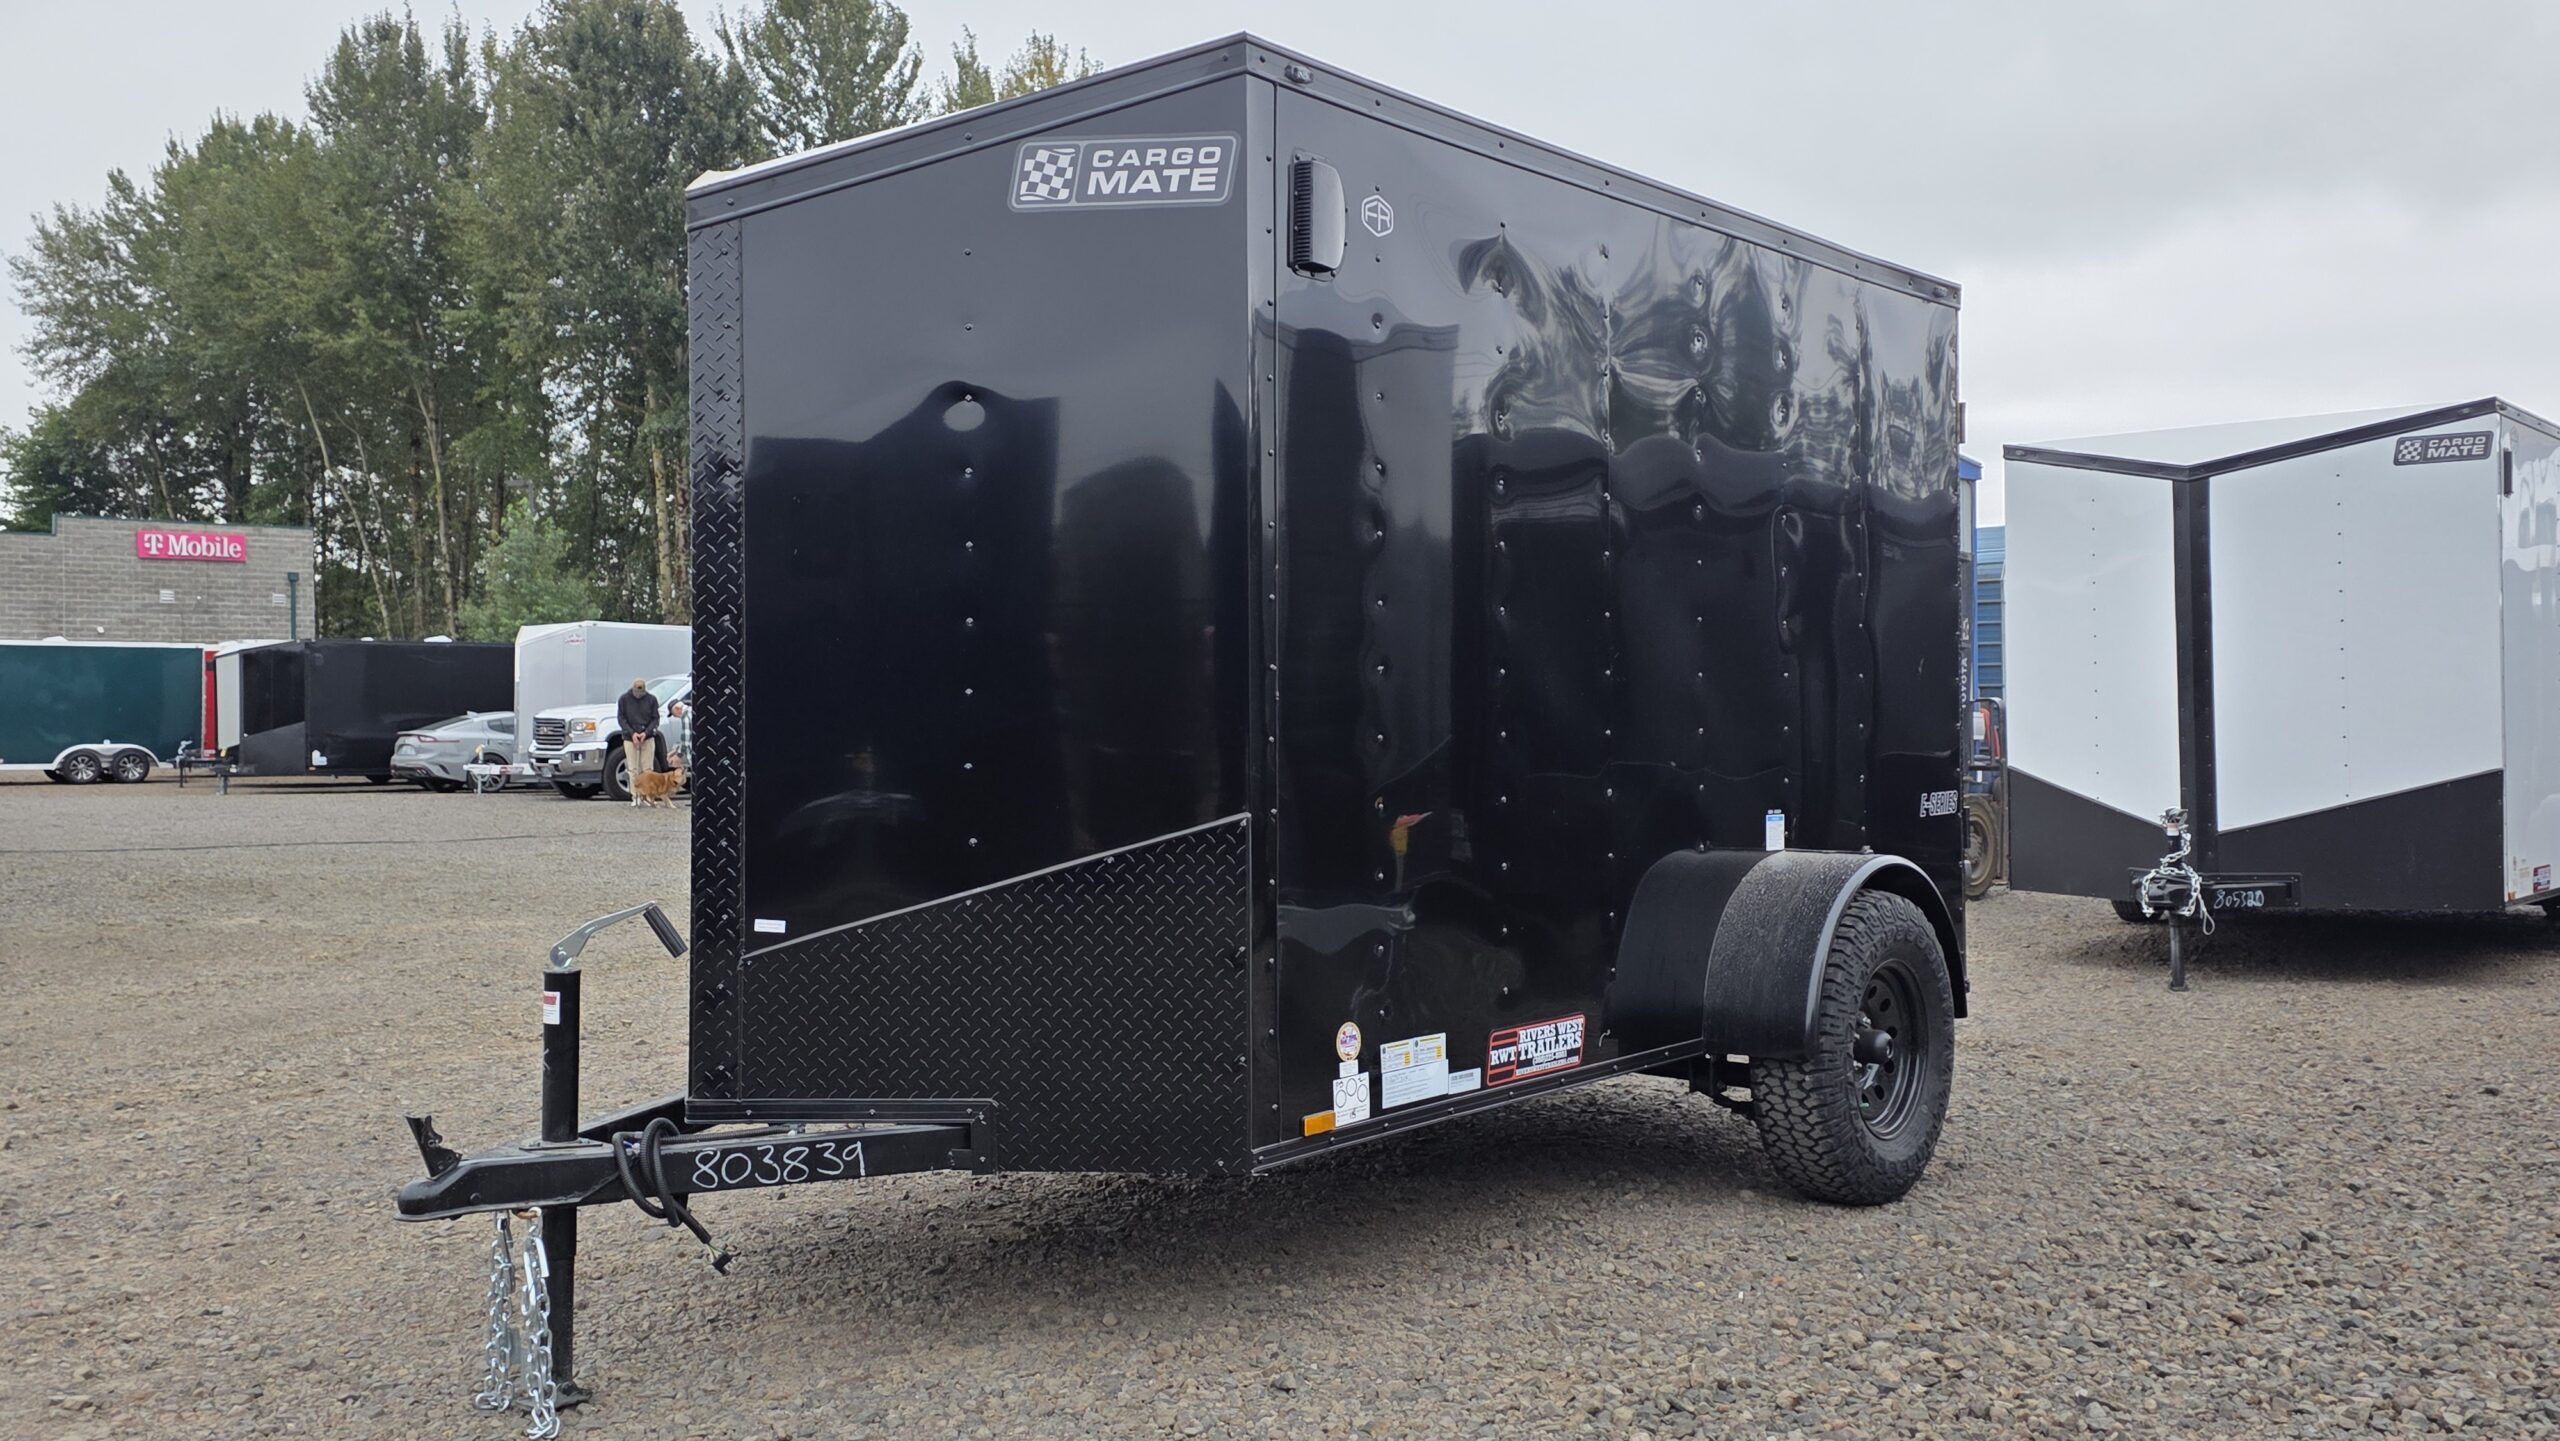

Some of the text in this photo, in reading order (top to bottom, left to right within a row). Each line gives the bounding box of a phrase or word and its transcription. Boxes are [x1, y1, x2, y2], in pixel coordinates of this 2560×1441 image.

[1092, 146, 1222, 168] CARGO
[1087, 167, 1219, 195] MATE
[2426, 444, 2486, 459] MATE
[2428, 436, 2486, 448] CARGO
[167, 533, 242, 558] Mobile
[1919, 789, 1959, 818] E-SERIES
[1518, 1017, 1584, 1043] RIVERS WEST
[1490, 1045, 1517, 1066] RWT
[1518, 1031, 1583, 1061] TRAILERS
[692, 1140, 866, 1189] 803839
